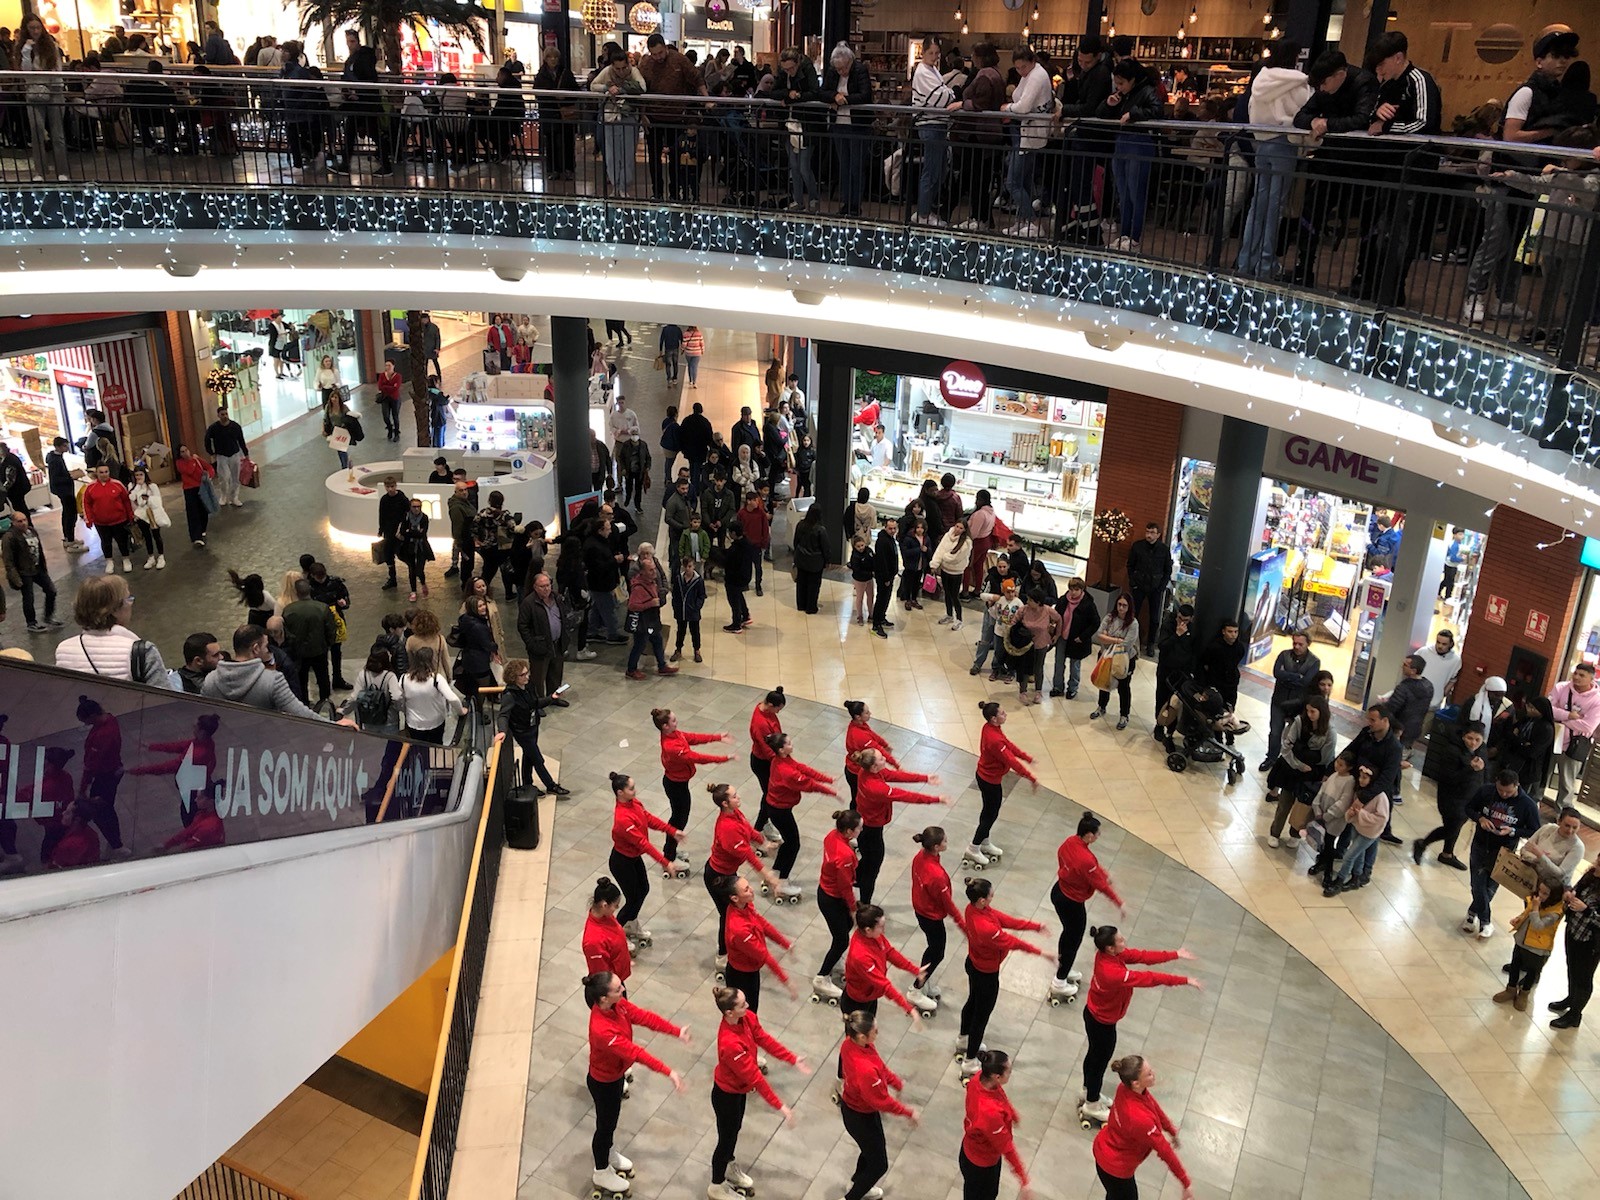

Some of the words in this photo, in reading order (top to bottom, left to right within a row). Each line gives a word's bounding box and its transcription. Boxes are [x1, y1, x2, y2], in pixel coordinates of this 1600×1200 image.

[1284, 435, 1380, 485] GAME
[214, 747, 252, 819] JA
[258, 749, 309, 816] SOM
[311, 739, 355, 822] AQUÍ
